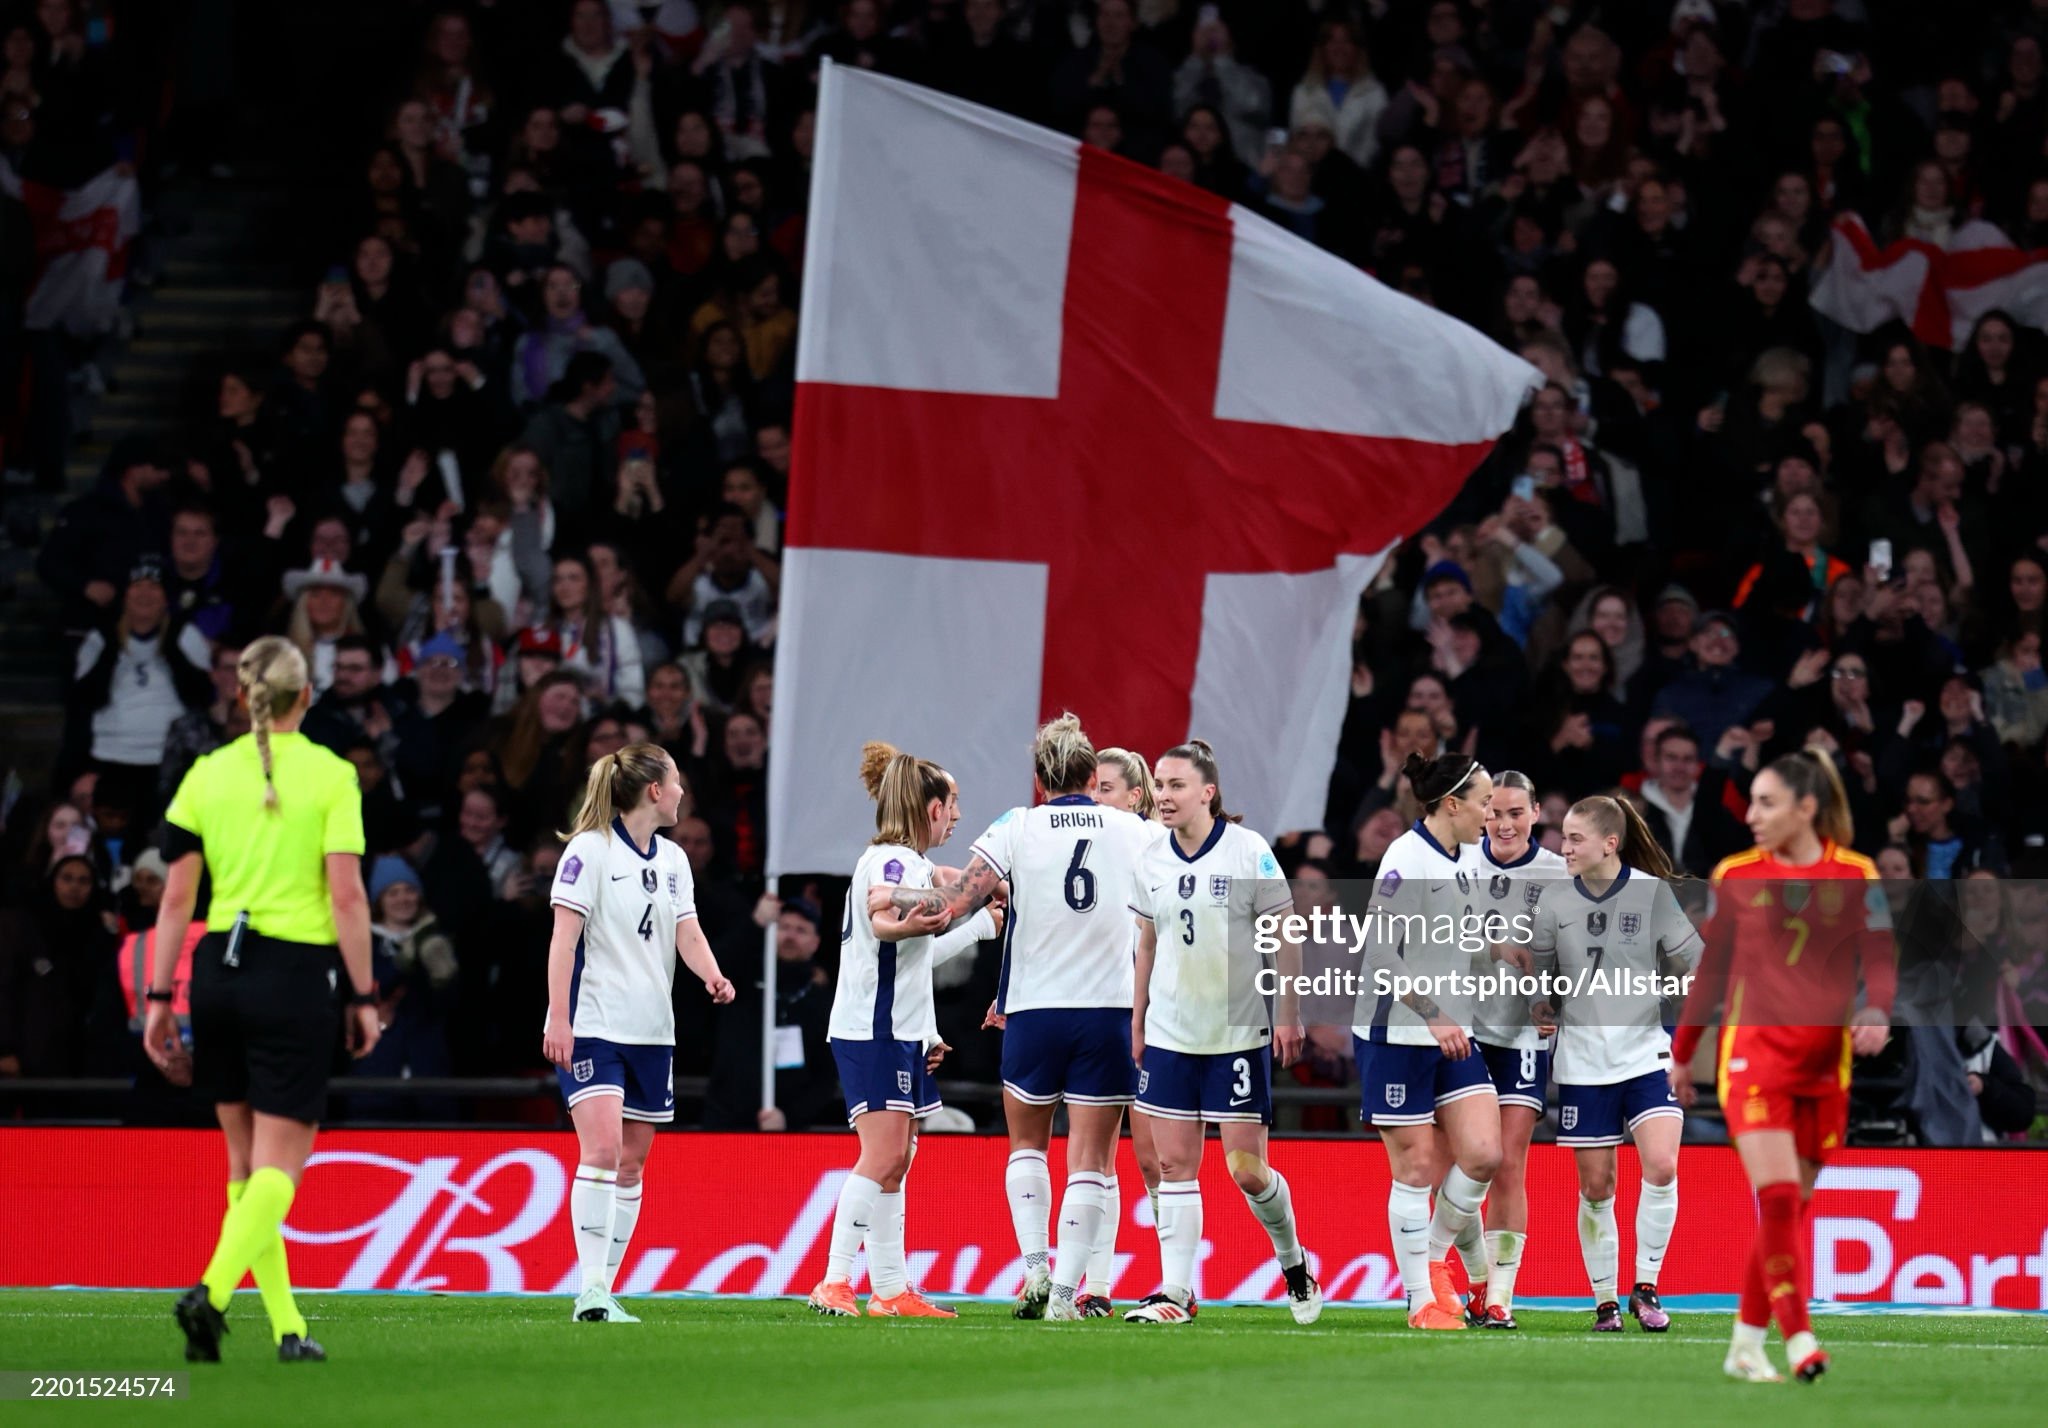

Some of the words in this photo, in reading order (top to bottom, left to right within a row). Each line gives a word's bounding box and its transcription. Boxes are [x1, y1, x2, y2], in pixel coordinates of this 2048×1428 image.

[1050, 811, 1104, 829] BRIGHT
[1064, 839, 1098, 913] 6
[637, 903, 653, 941] 4
[1180, 908, 1195, 945] 3
[1784, 916, 1809, 966] 7
[1586, 947, 1604, 984] 7
[1232, 1057, 1251, 1097] 3
[1520, 1048, 1537, 1082] 8
